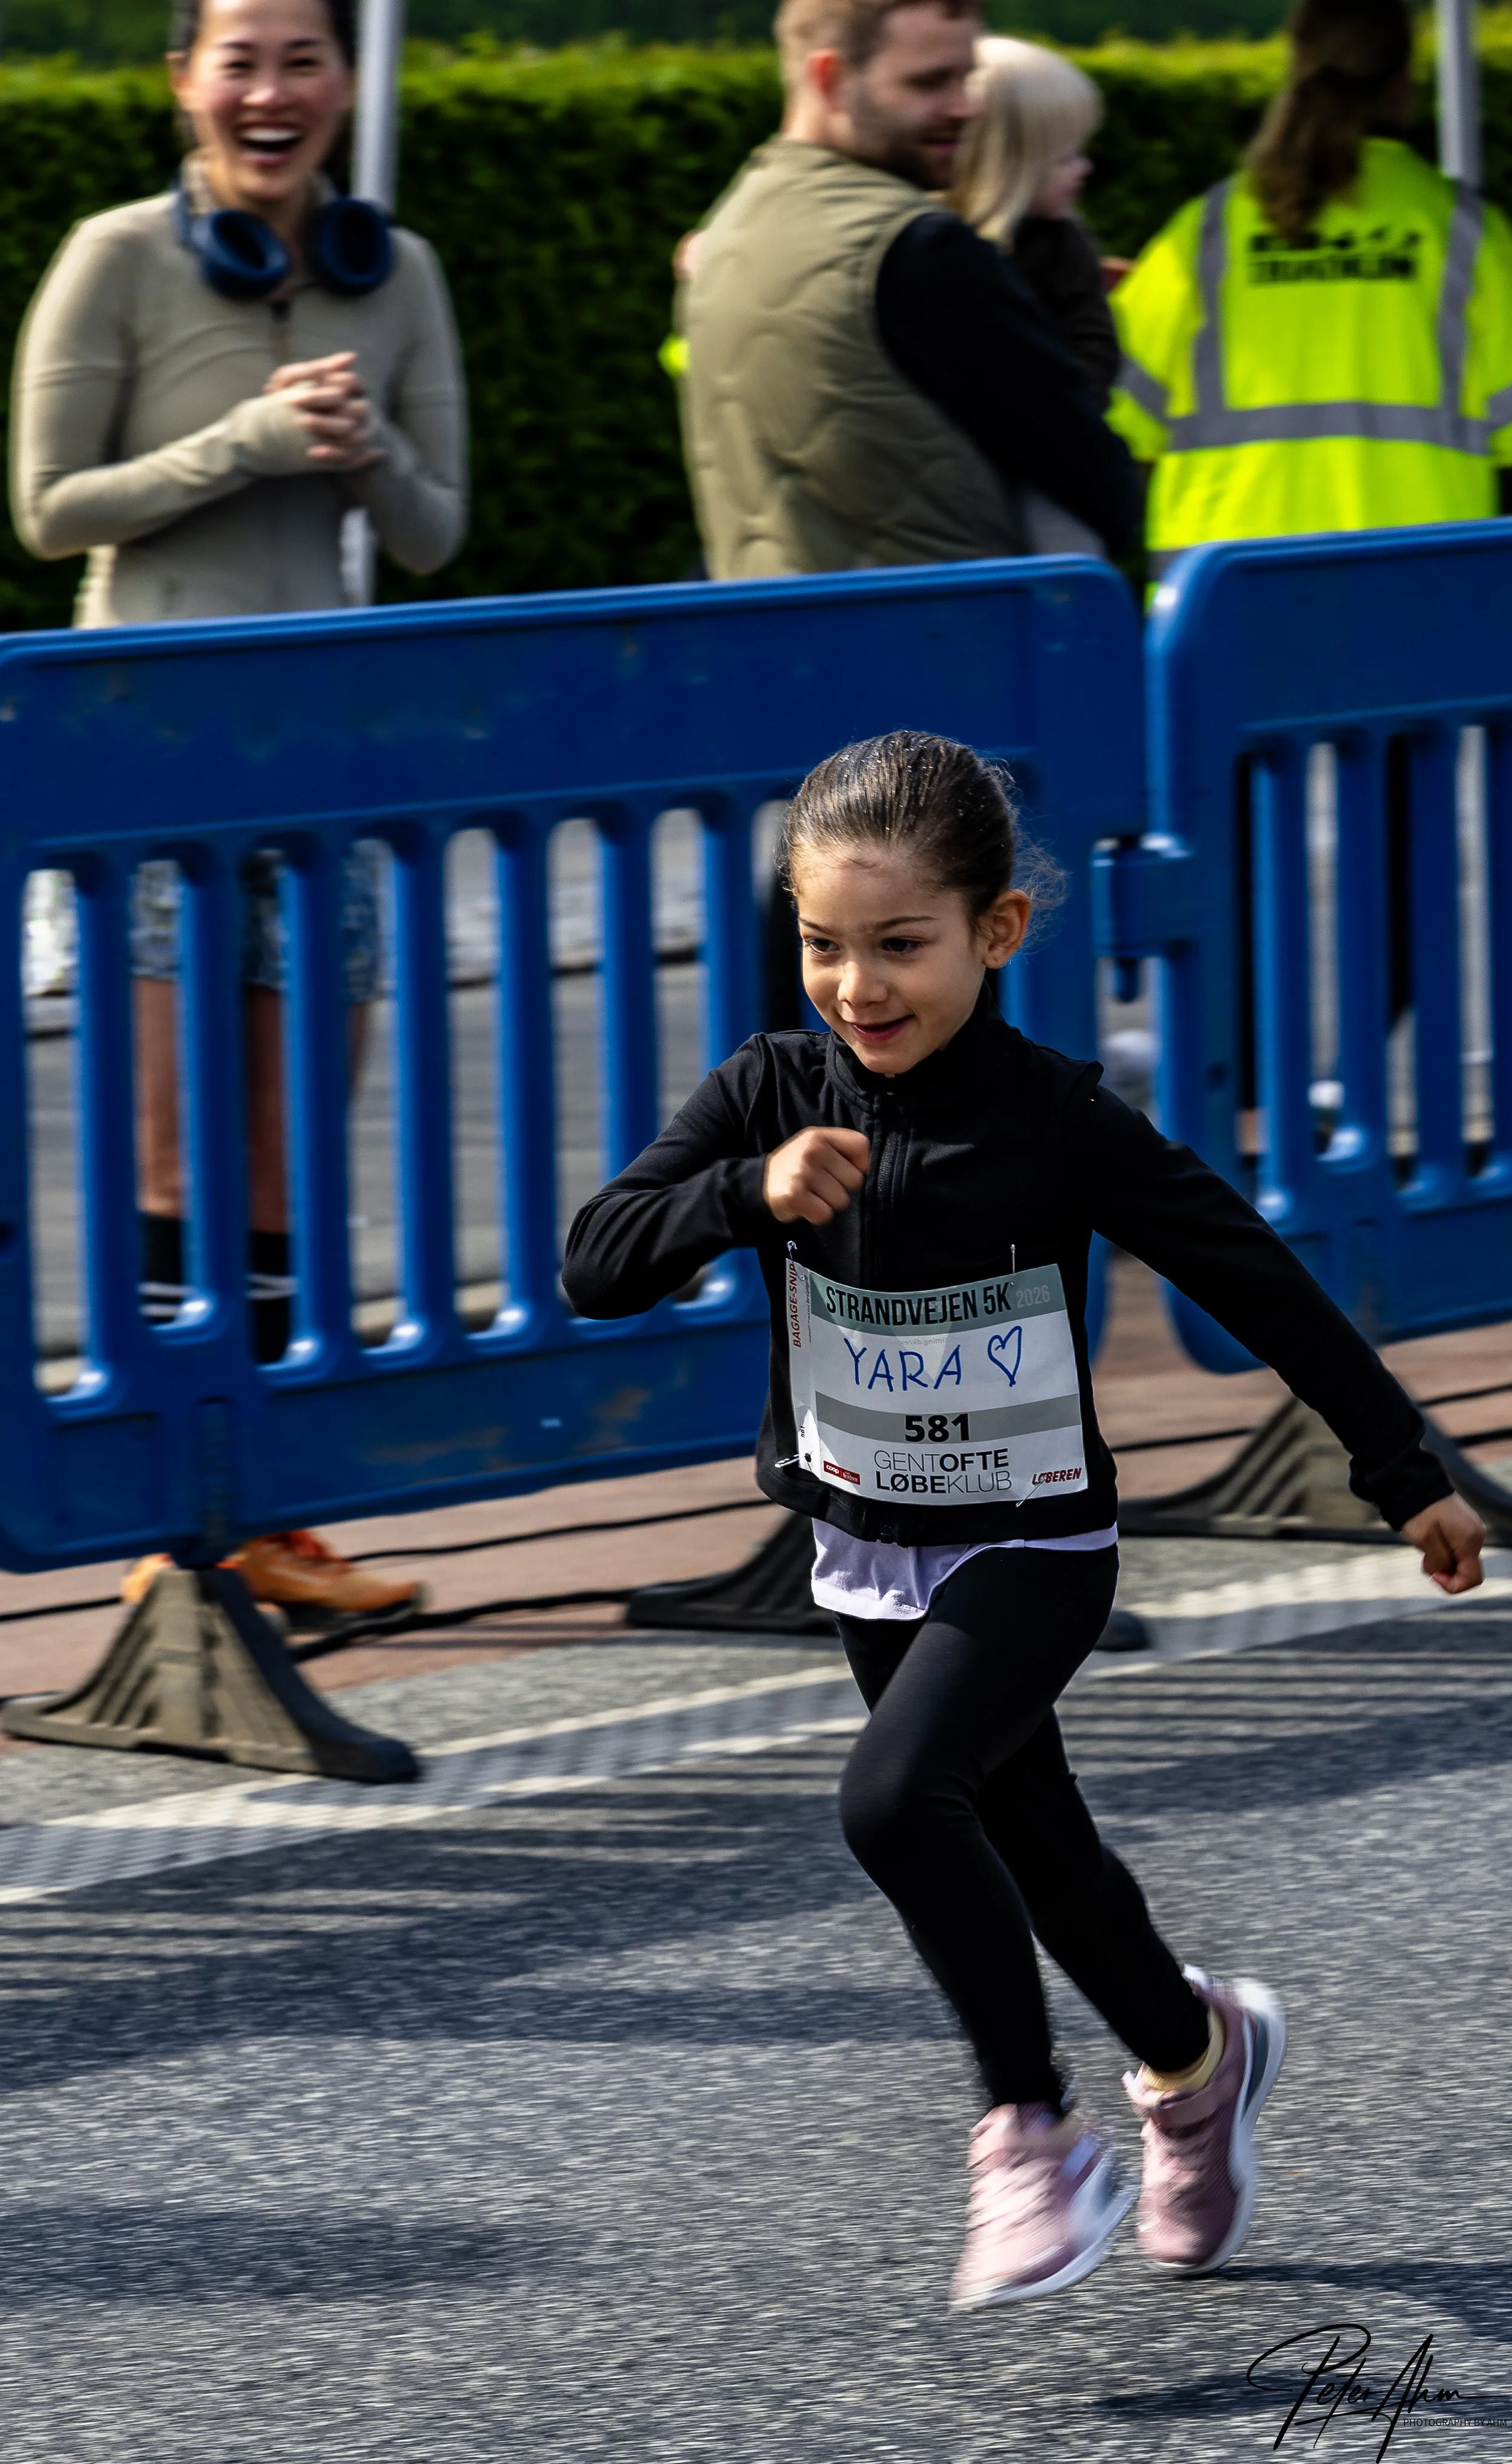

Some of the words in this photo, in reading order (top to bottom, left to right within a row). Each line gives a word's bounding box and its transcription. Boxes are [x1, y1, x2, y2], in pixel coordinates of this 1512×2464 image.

[789, 1263, 801, 1348] BAGAGE-SNIP
[826, 1285, 979, 1327] STRANDVEJEN
[983, 1281, 1012, 1315] 5K
[1016, 1285, 1051, 1308] 2026
[844, 1337, 962, 1392] YARA
[905, 1413, 970, 1443] 581
[826, 1464, 839, 1475] coop
[874, 1448, 1009, 1473] GENTOFTE
[876, 1470, 1012, 1494] LØBEKLUB
